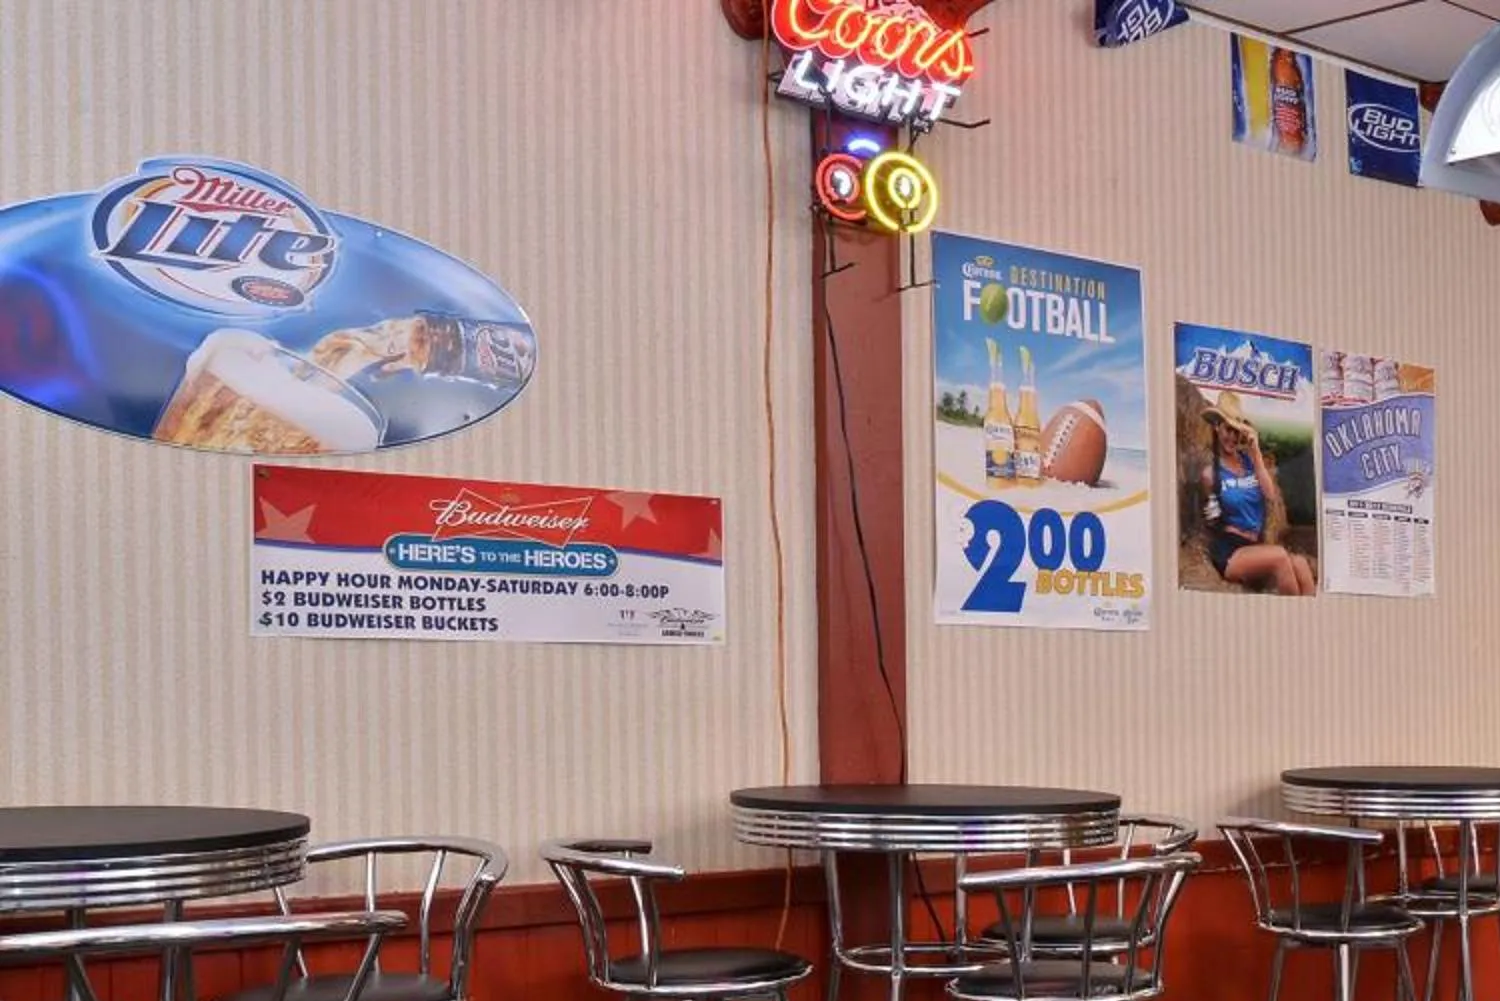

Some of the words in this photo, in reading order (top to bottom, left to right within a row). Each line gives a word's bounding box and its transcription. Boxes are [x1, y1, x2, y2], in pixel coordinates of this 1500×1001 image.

[780, 0, 975, 78] Coors
[795, 50, 961, 120] LIGHT
[1352, 118, 1420, 146] LIGHT
[1363, 108, 1414, 131] BUD
[173, 167, 296, 214] Miller
[102, 201, 331, 271] Lite
[1010, 265, 1106, 301] DESTINATION
[1193, 347, 1300, 392] BUSCH
[1325, 408, 1421, 458] OKLAHOMA
[1361, 443, 1401, 479] CITY
[429, 498, 590, 531] Budweiser
[397, 542, 477, 564] HERE'S
[480, 550, 497, 562] TO
[499, 551, 521, 563] THE
[524, 549, 607, 570] HEROES
[261, 569, 330, 587] HAPPY
[336, 571, 391, 590] HOUR
[399, 574, 578, 596] MONDAY-SATURDAY
[1034, 567, 1145, 598] BOTTLES
[261, 589, 286, 607] $2
[293, 591, 404, 610] BUDWEISER
[409, 595, 487, 612] BOTTLES
[259, 611, 299, 627] $10
[306, 612, 416, 630] BUDWEISER
[421, 615, 499, 632] BUCKETS
